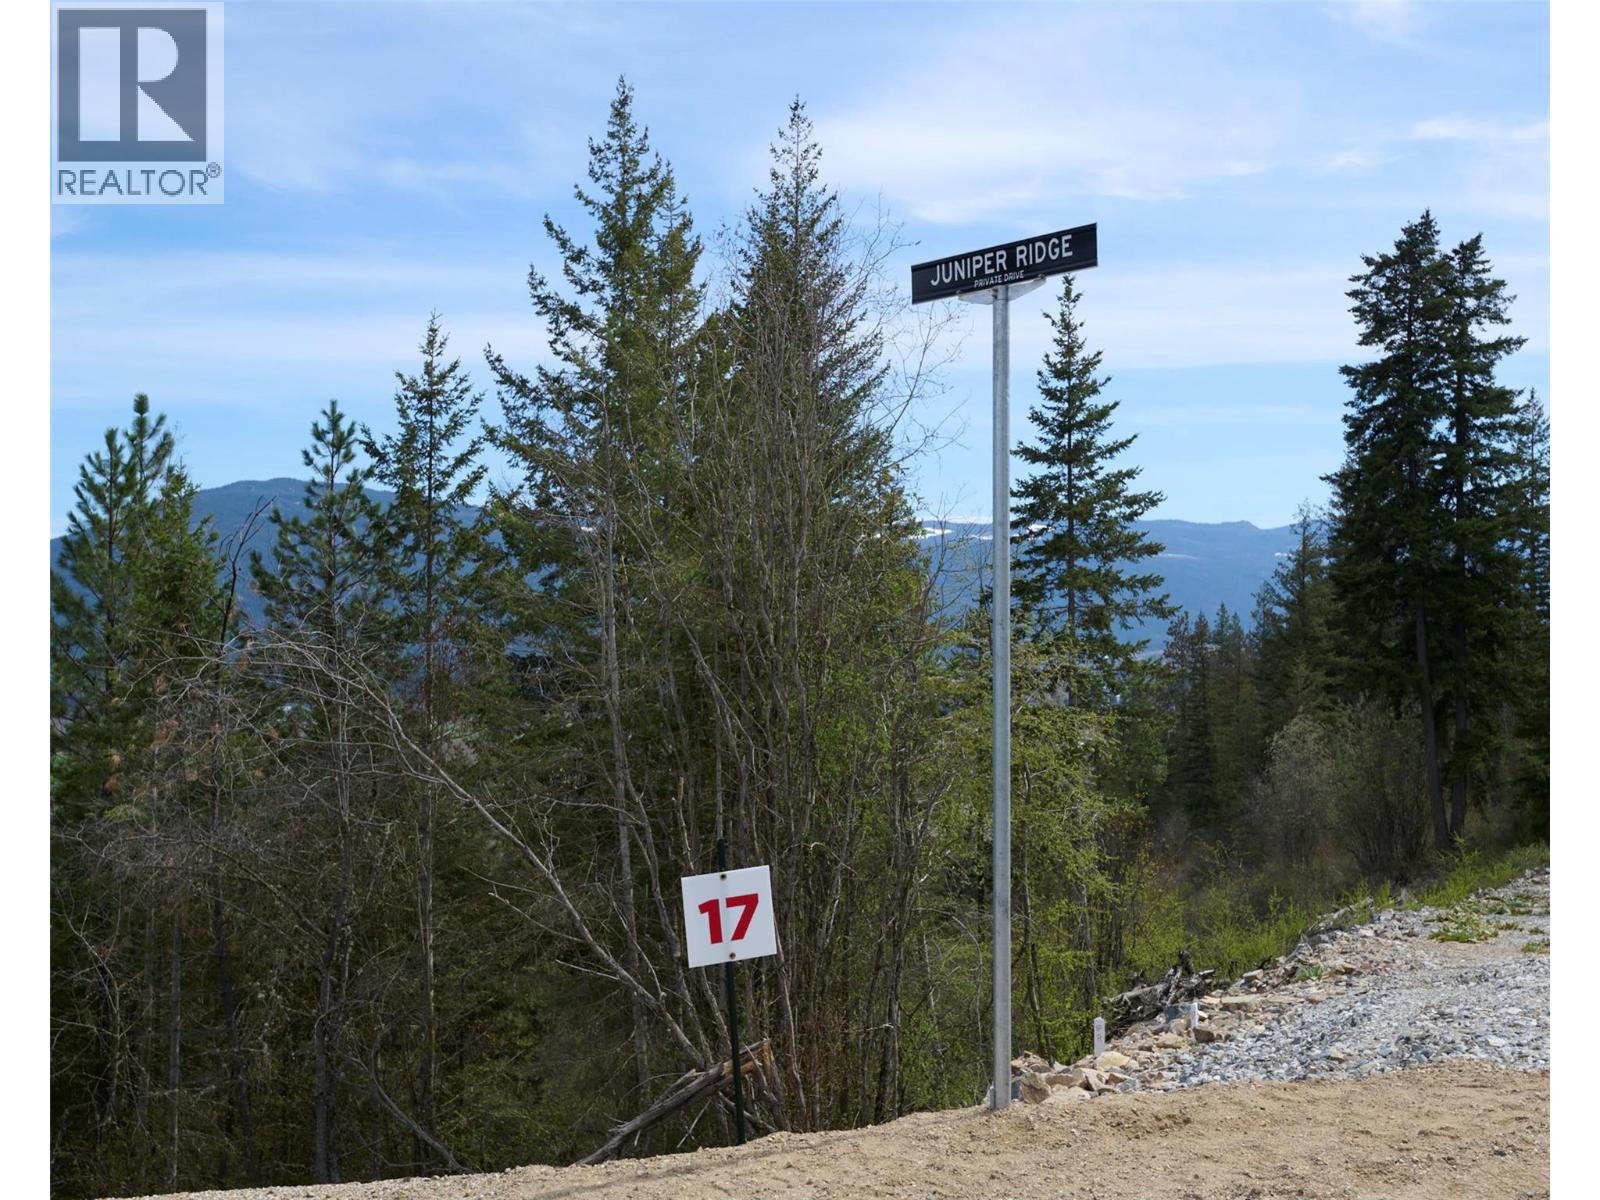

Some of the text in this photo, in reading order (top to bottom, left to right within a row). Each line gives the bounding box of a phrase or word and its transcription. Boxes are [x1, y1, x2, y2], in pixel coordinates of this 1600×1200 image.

[930, 234, 1073, 286] JUNIPER RIDGE
[974, 270, 1025, 289] PRIVATE DRIVE
[698, 893, 759, 945] 17
